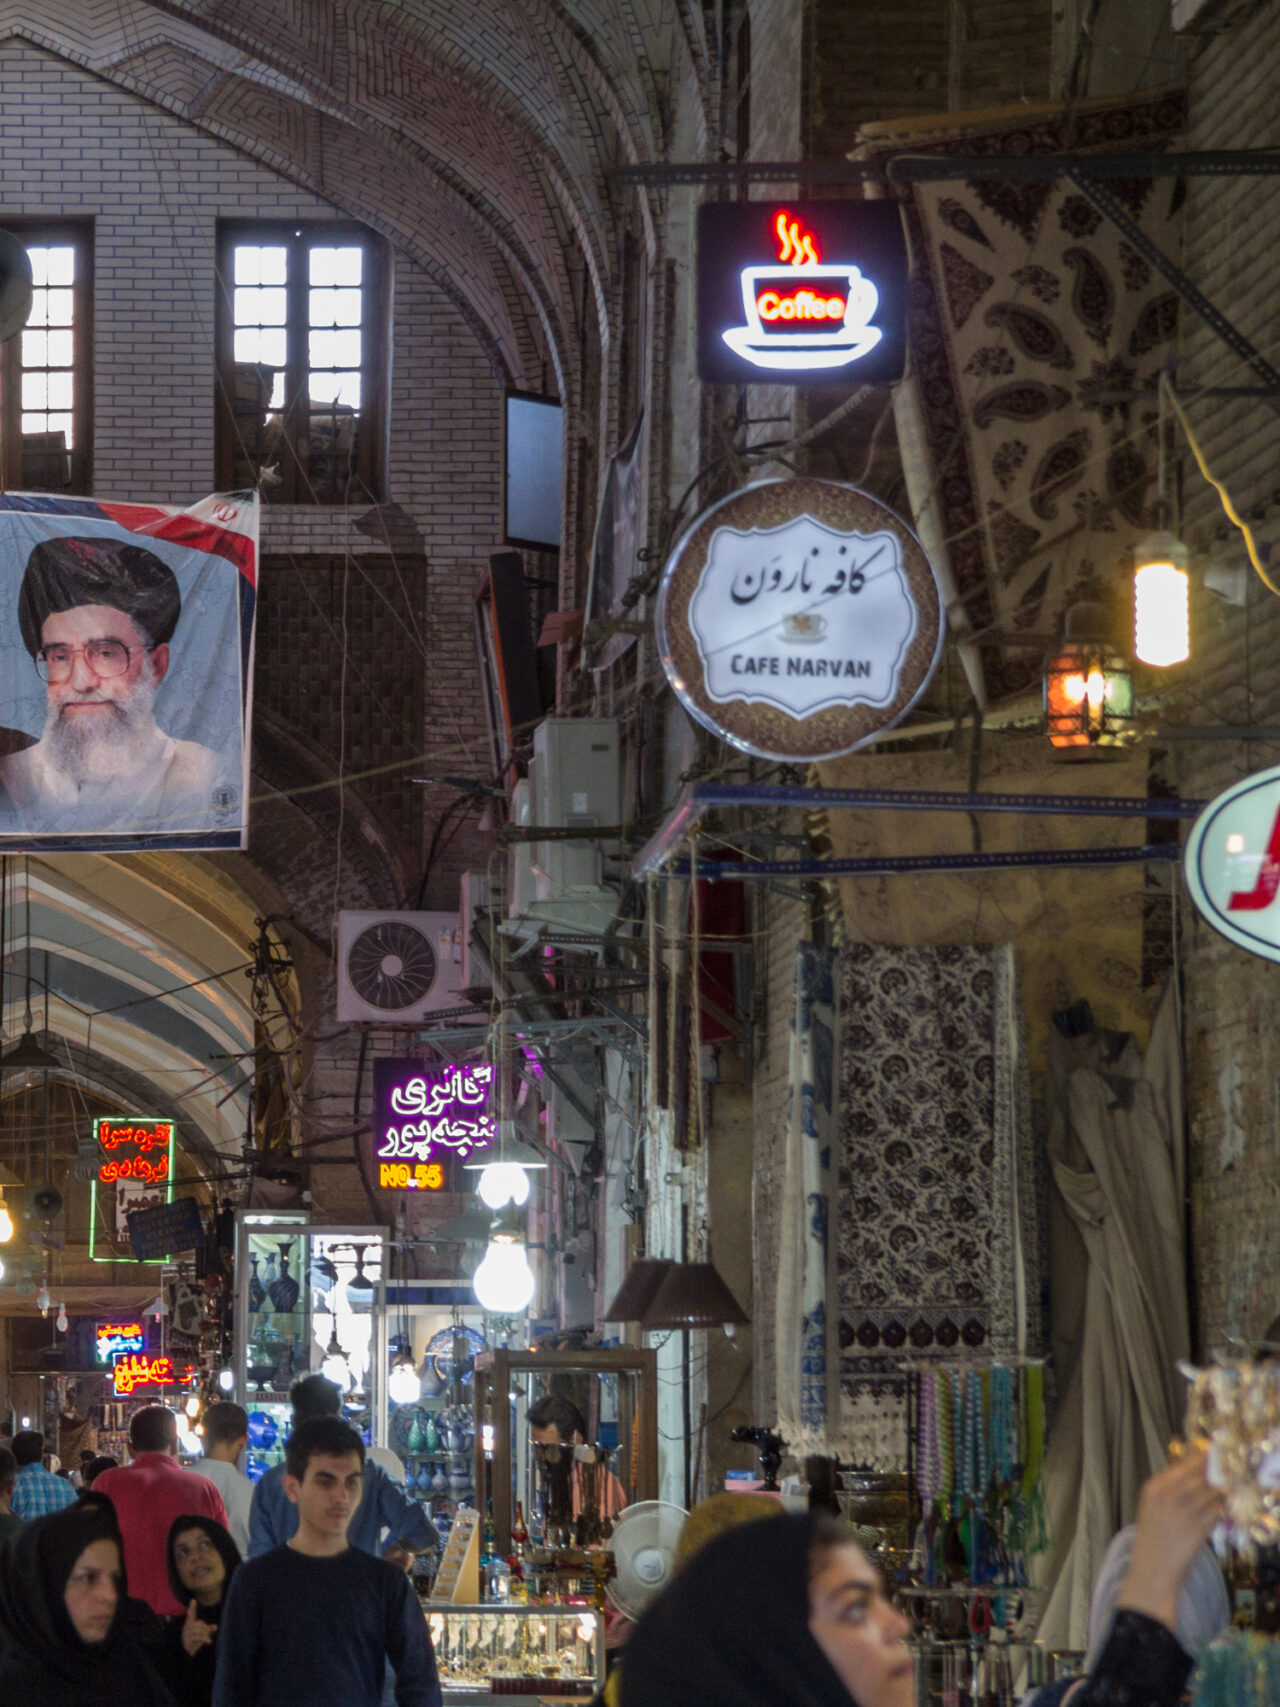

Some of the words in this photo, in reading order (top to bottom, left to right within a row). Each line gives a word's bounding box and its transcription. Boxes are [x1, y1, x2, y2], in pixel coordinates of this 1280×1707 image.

[757, 291, 846, 320] Coffee
[821, 544, 886, 595] کافه
[730, 654, 780, 676] CAFE
[786, 656, 871, 678] NARVAN
